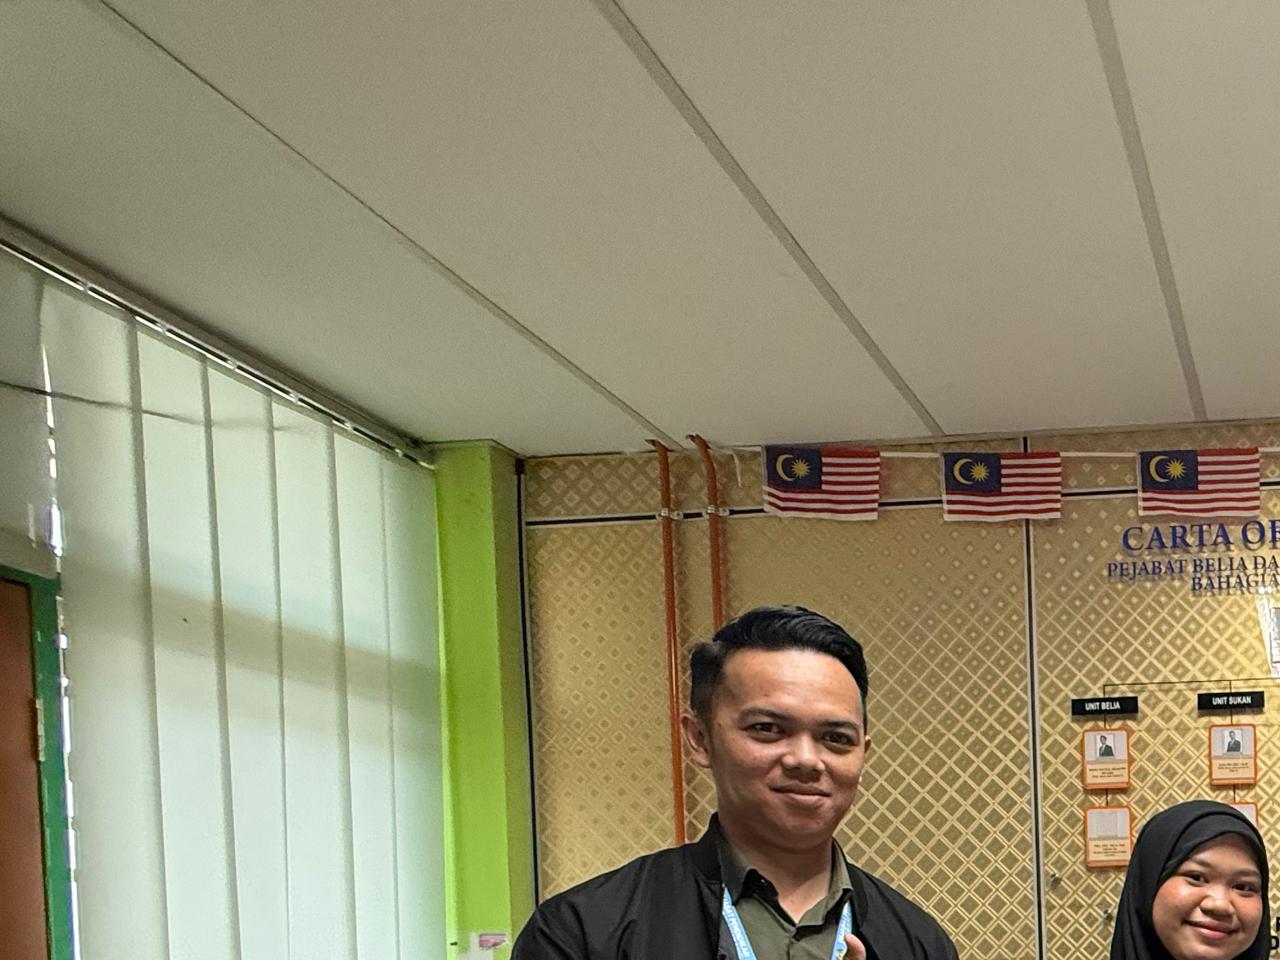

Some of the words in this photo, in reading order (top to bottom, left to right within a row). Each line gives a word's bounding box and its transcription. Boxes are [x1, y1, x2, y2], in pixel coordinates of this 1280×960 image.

[1121, 522, 1233, 551] CARTA
[1106, 559, 1187, 580] PEJABAT
[1193, 556, 1248, 574] BELIA
[1085, 701, 1100, 711] UNIT
[1101, 701, 1120, 711] BELIA
[1212, 696, 1227, 706] UNIT
[1229, 695, 1251, 705] SUKAN
